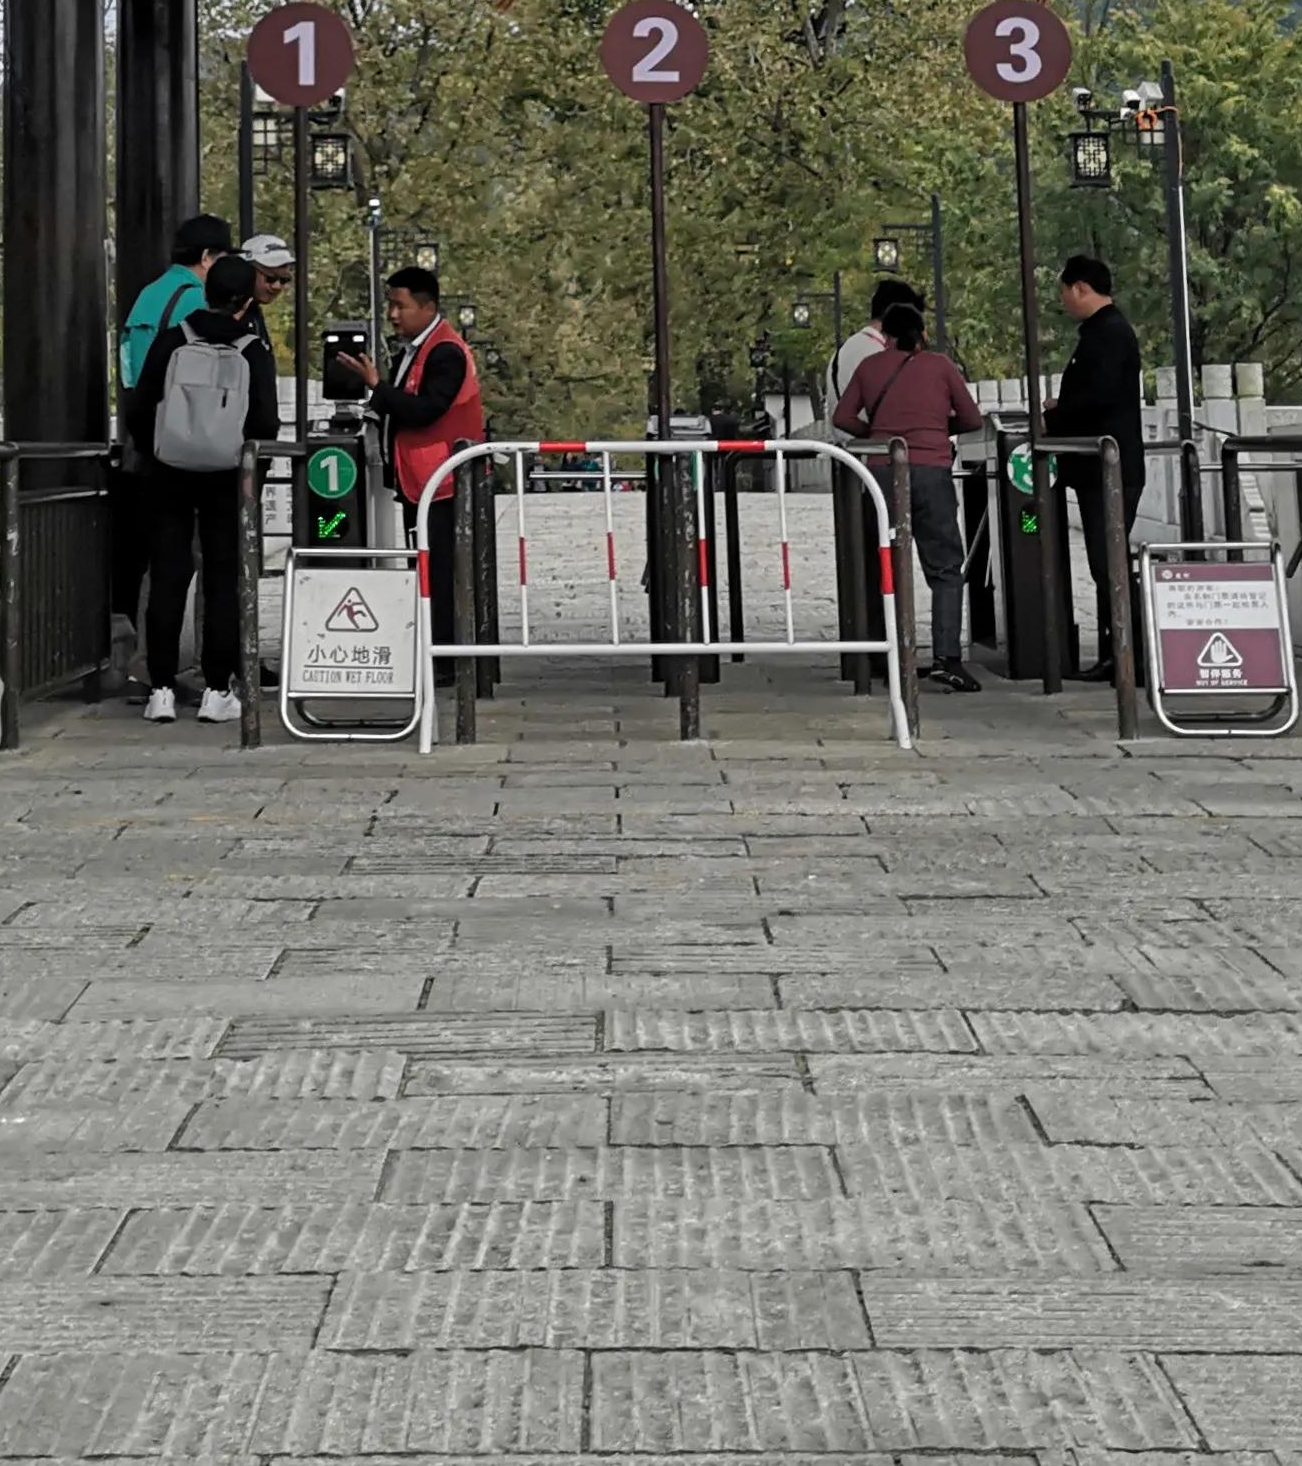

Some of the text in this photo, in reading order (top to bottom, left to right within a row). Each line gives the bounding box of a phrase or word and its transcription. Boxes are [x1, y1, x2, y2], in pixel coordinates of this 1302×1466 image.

[283, 21, 316, 86] 1
[632, 17, 680, 82] 2
[995, 17, 1042, 83] 3
[320, 455, 339, 492] 1
[303, 670, 393, 684] CAUTION WET FLOOR
[307, 644, 392, 665] 小心地滑
